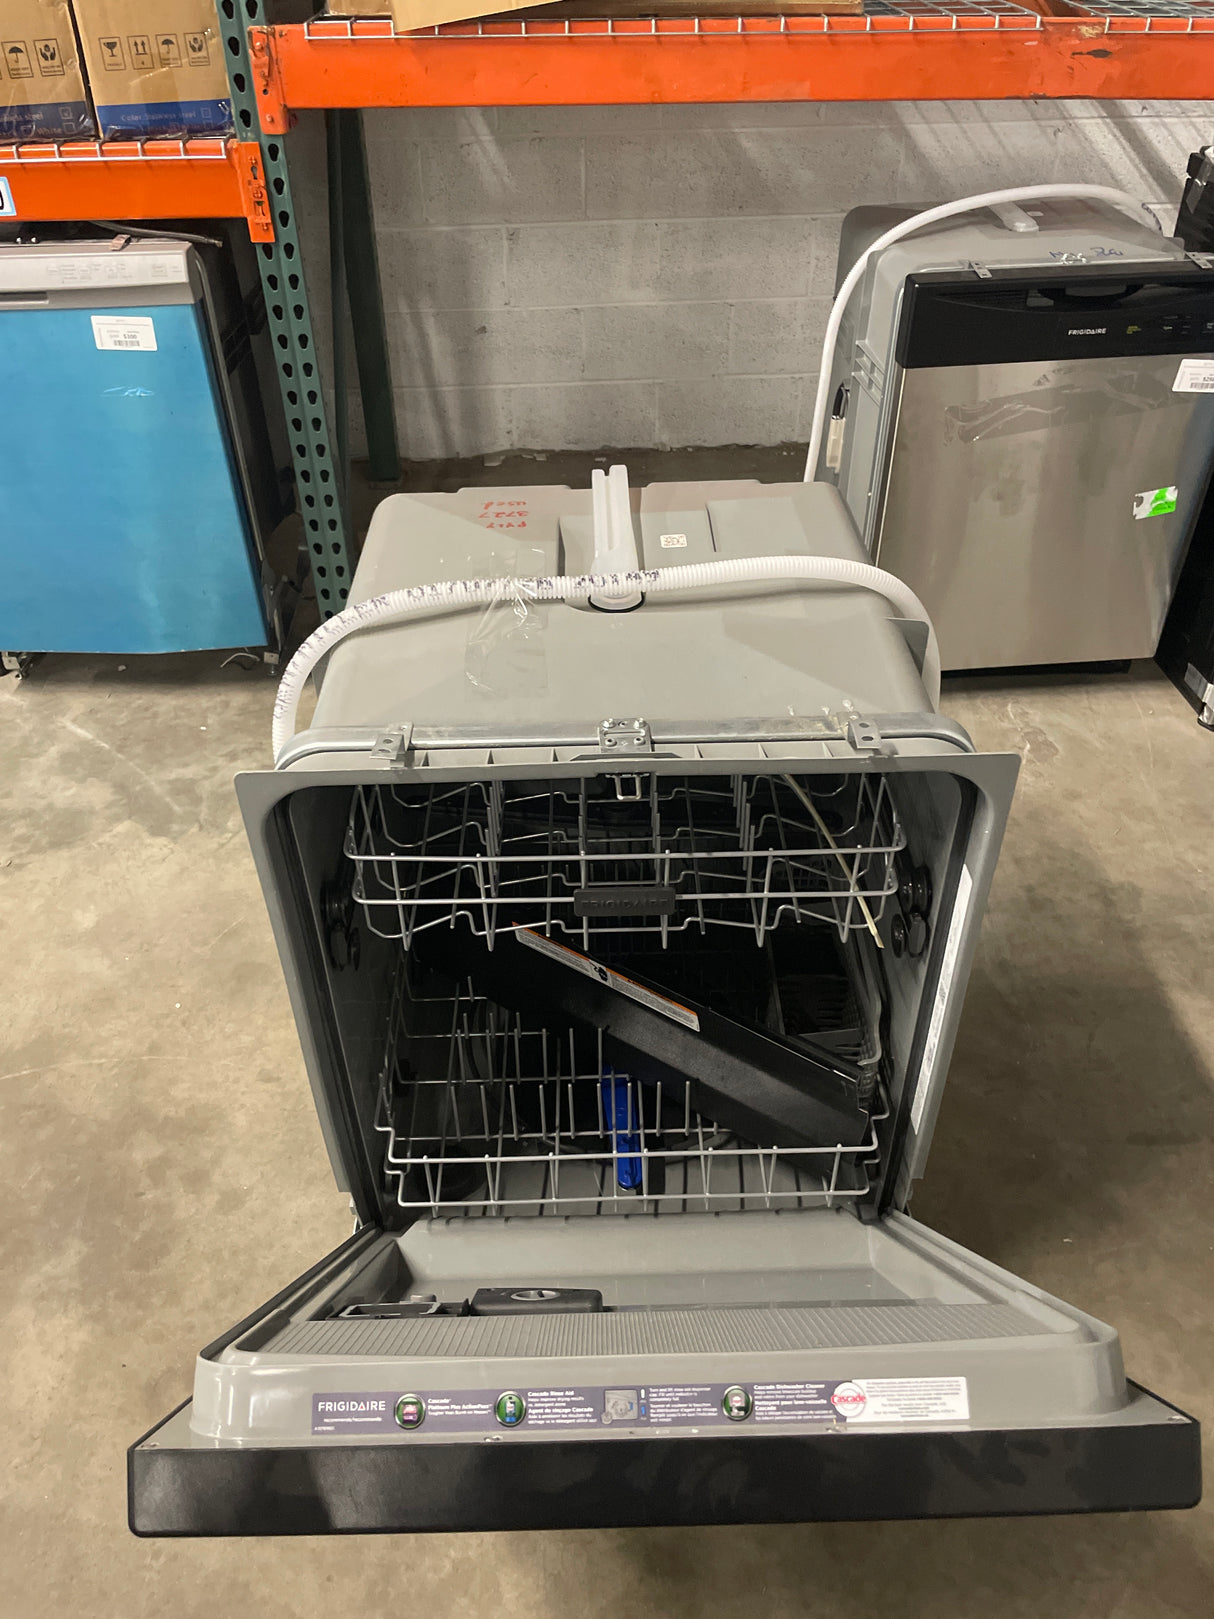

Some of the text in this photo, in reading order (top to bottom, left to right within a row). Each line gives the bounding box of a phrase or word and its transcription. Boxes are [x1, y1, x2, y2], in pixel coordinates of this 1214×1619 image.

[1068, 328, 1106, 336] FRIGIDAIRE
[831, 1394, 866, 1405] Cascade
[318, 1401, 386, 1412] FRIGIDAIRE
